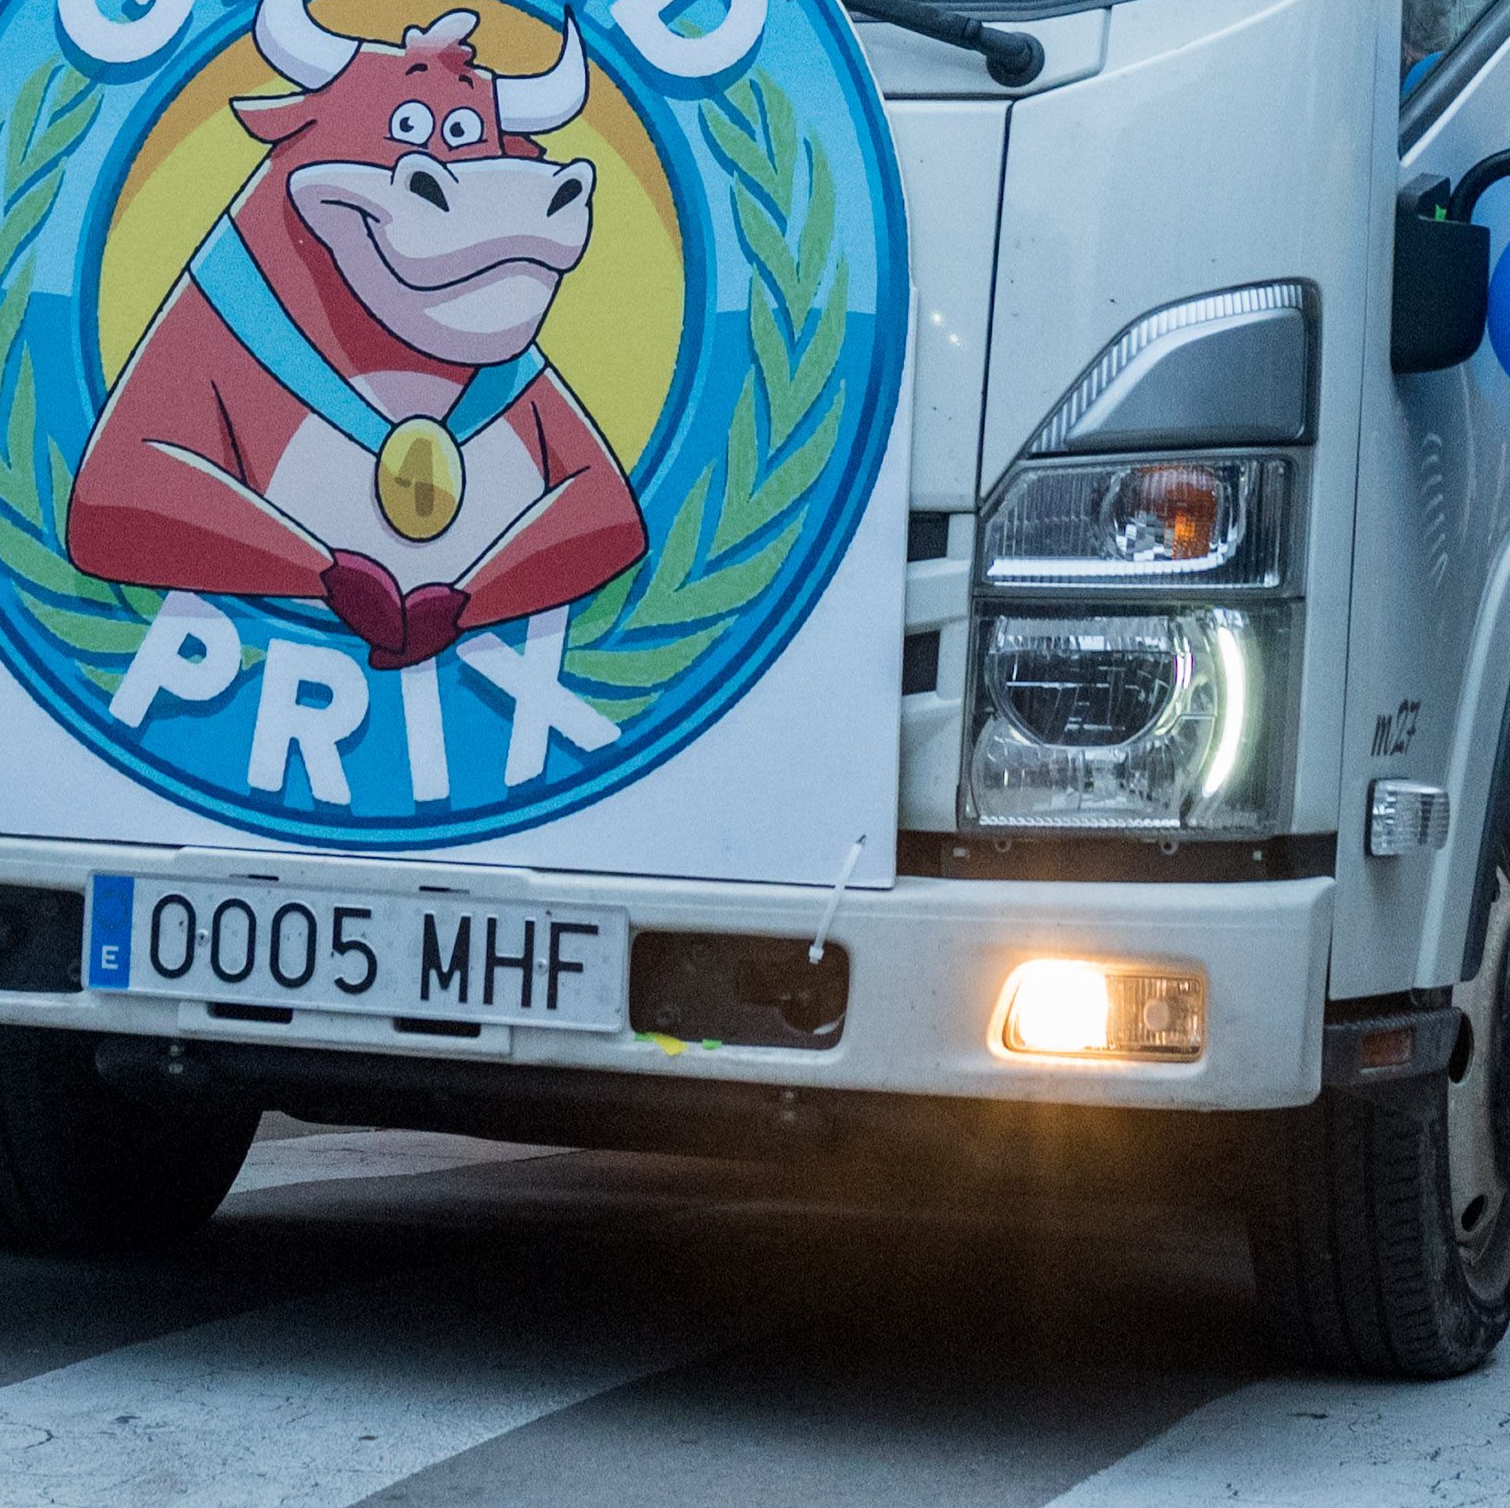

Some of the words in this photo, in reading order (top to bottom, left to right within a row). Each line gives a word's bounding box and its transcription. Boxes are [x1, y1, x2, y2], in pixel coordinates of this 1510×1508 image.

[107, 590, 621, 807] PRIX
[101, 944, 119, 970] E
[149, 893, 379, 995] 0005
[419, 910, 599, 1011] MHF
